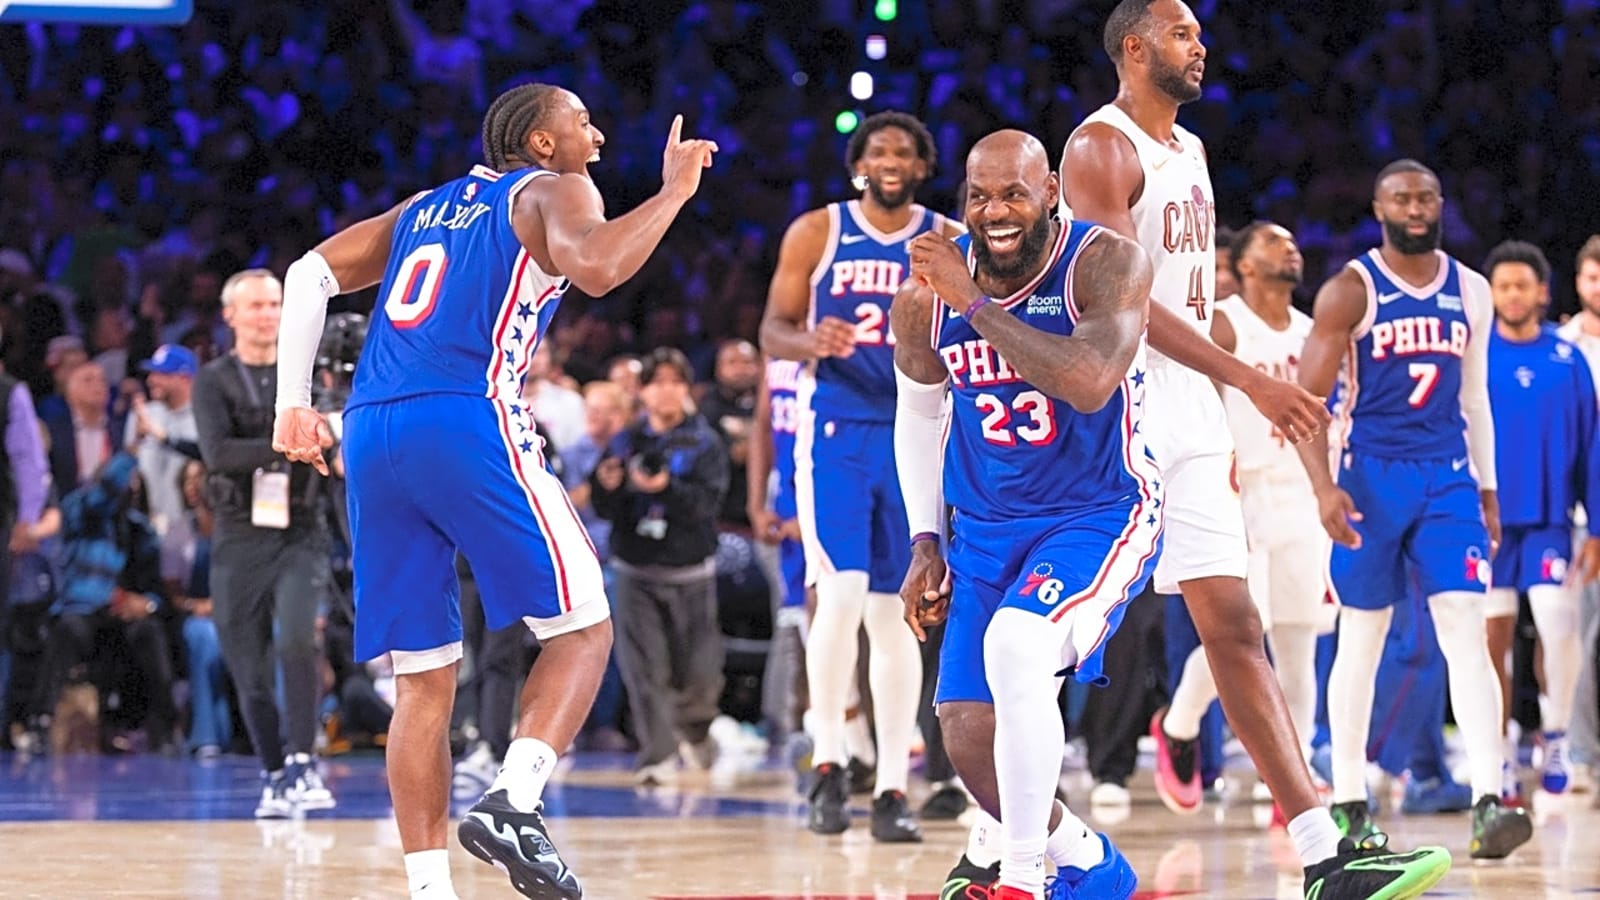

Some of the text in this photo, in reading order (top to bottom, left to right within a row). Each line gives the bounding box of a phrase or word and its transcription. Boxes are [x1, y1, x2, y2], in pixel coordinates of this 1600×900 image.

[384, 243, 448, 329] 0
[830, 260, 904, 297] PHIL
[1186, 264, 1207, 321] 4
[1027, 305, 1063, 316] energy
[940, 339, 1024, 388] PHI
[1408, 363, 1441, 409] 7
[975, 390, 1058, 446] 23
[1018, 571, 1065, 605] 76
